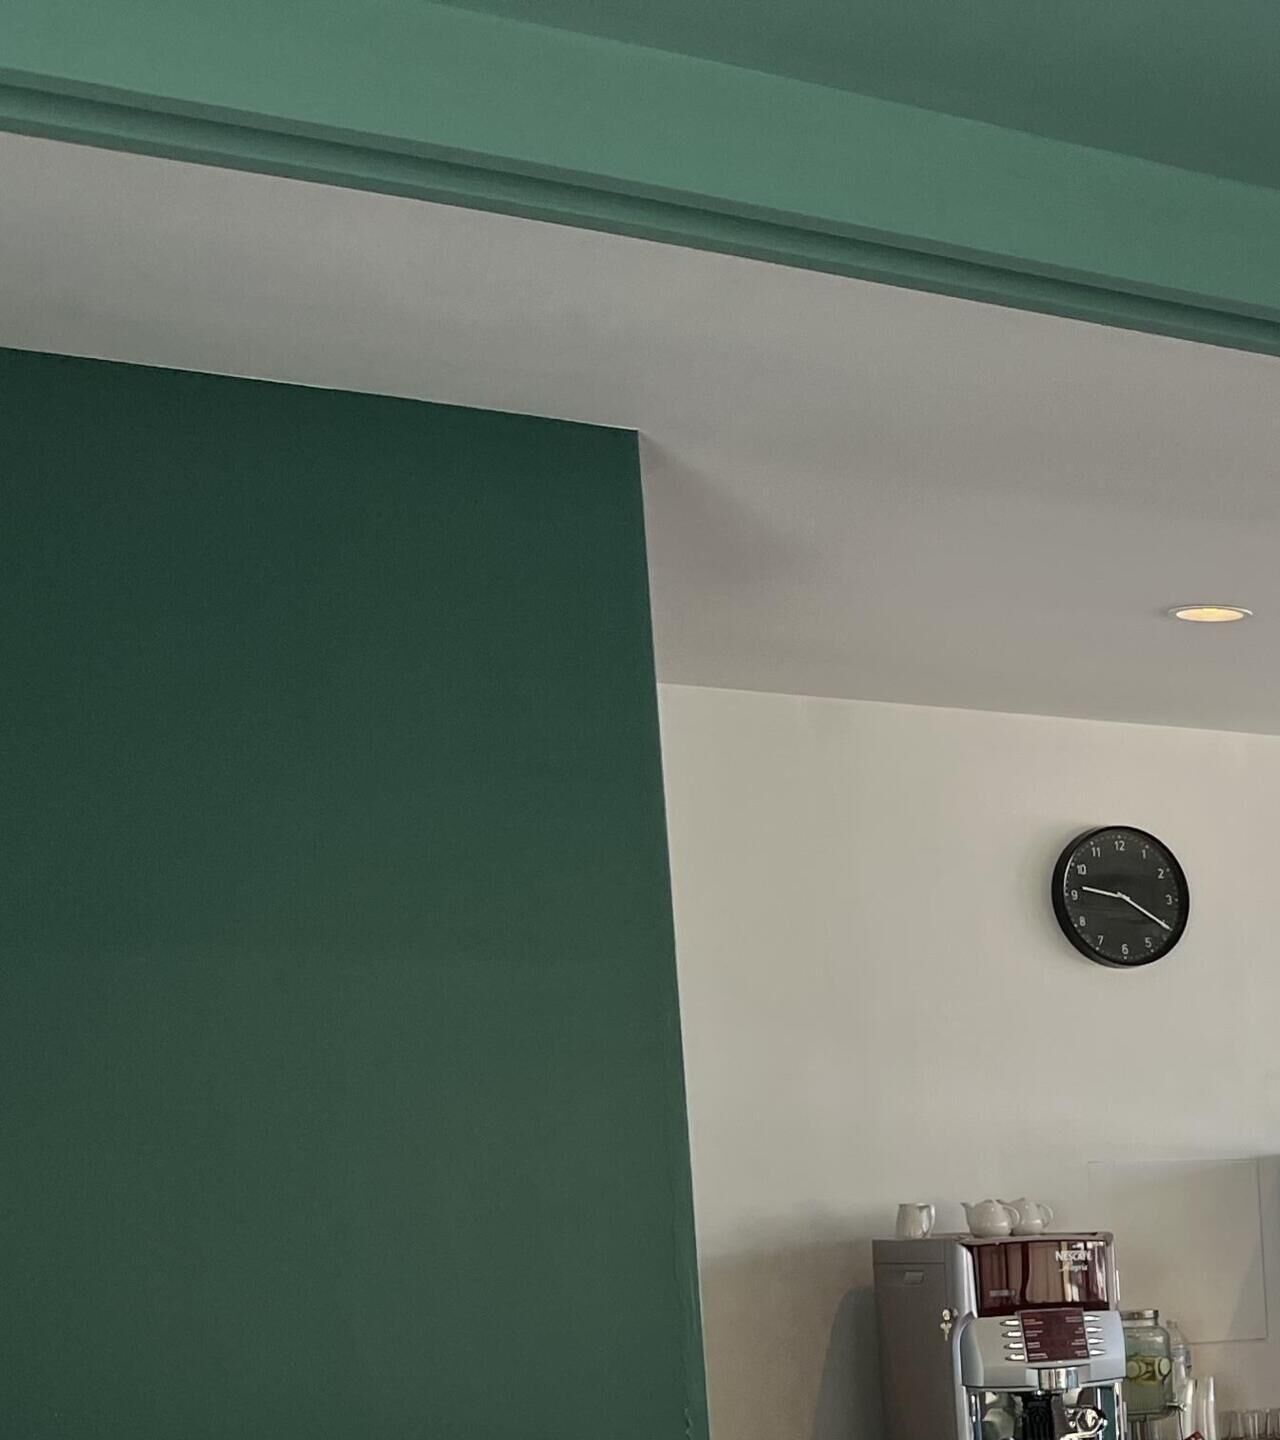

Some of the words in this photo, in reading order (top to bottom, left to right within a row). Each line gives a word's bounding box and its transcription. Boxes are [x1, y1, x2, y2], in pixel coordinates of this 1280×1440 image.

[1114, 840, 1125, 851] 12
[1091, 847, 1101, 858] 11
[1077, 863, 1087, 875] 10
